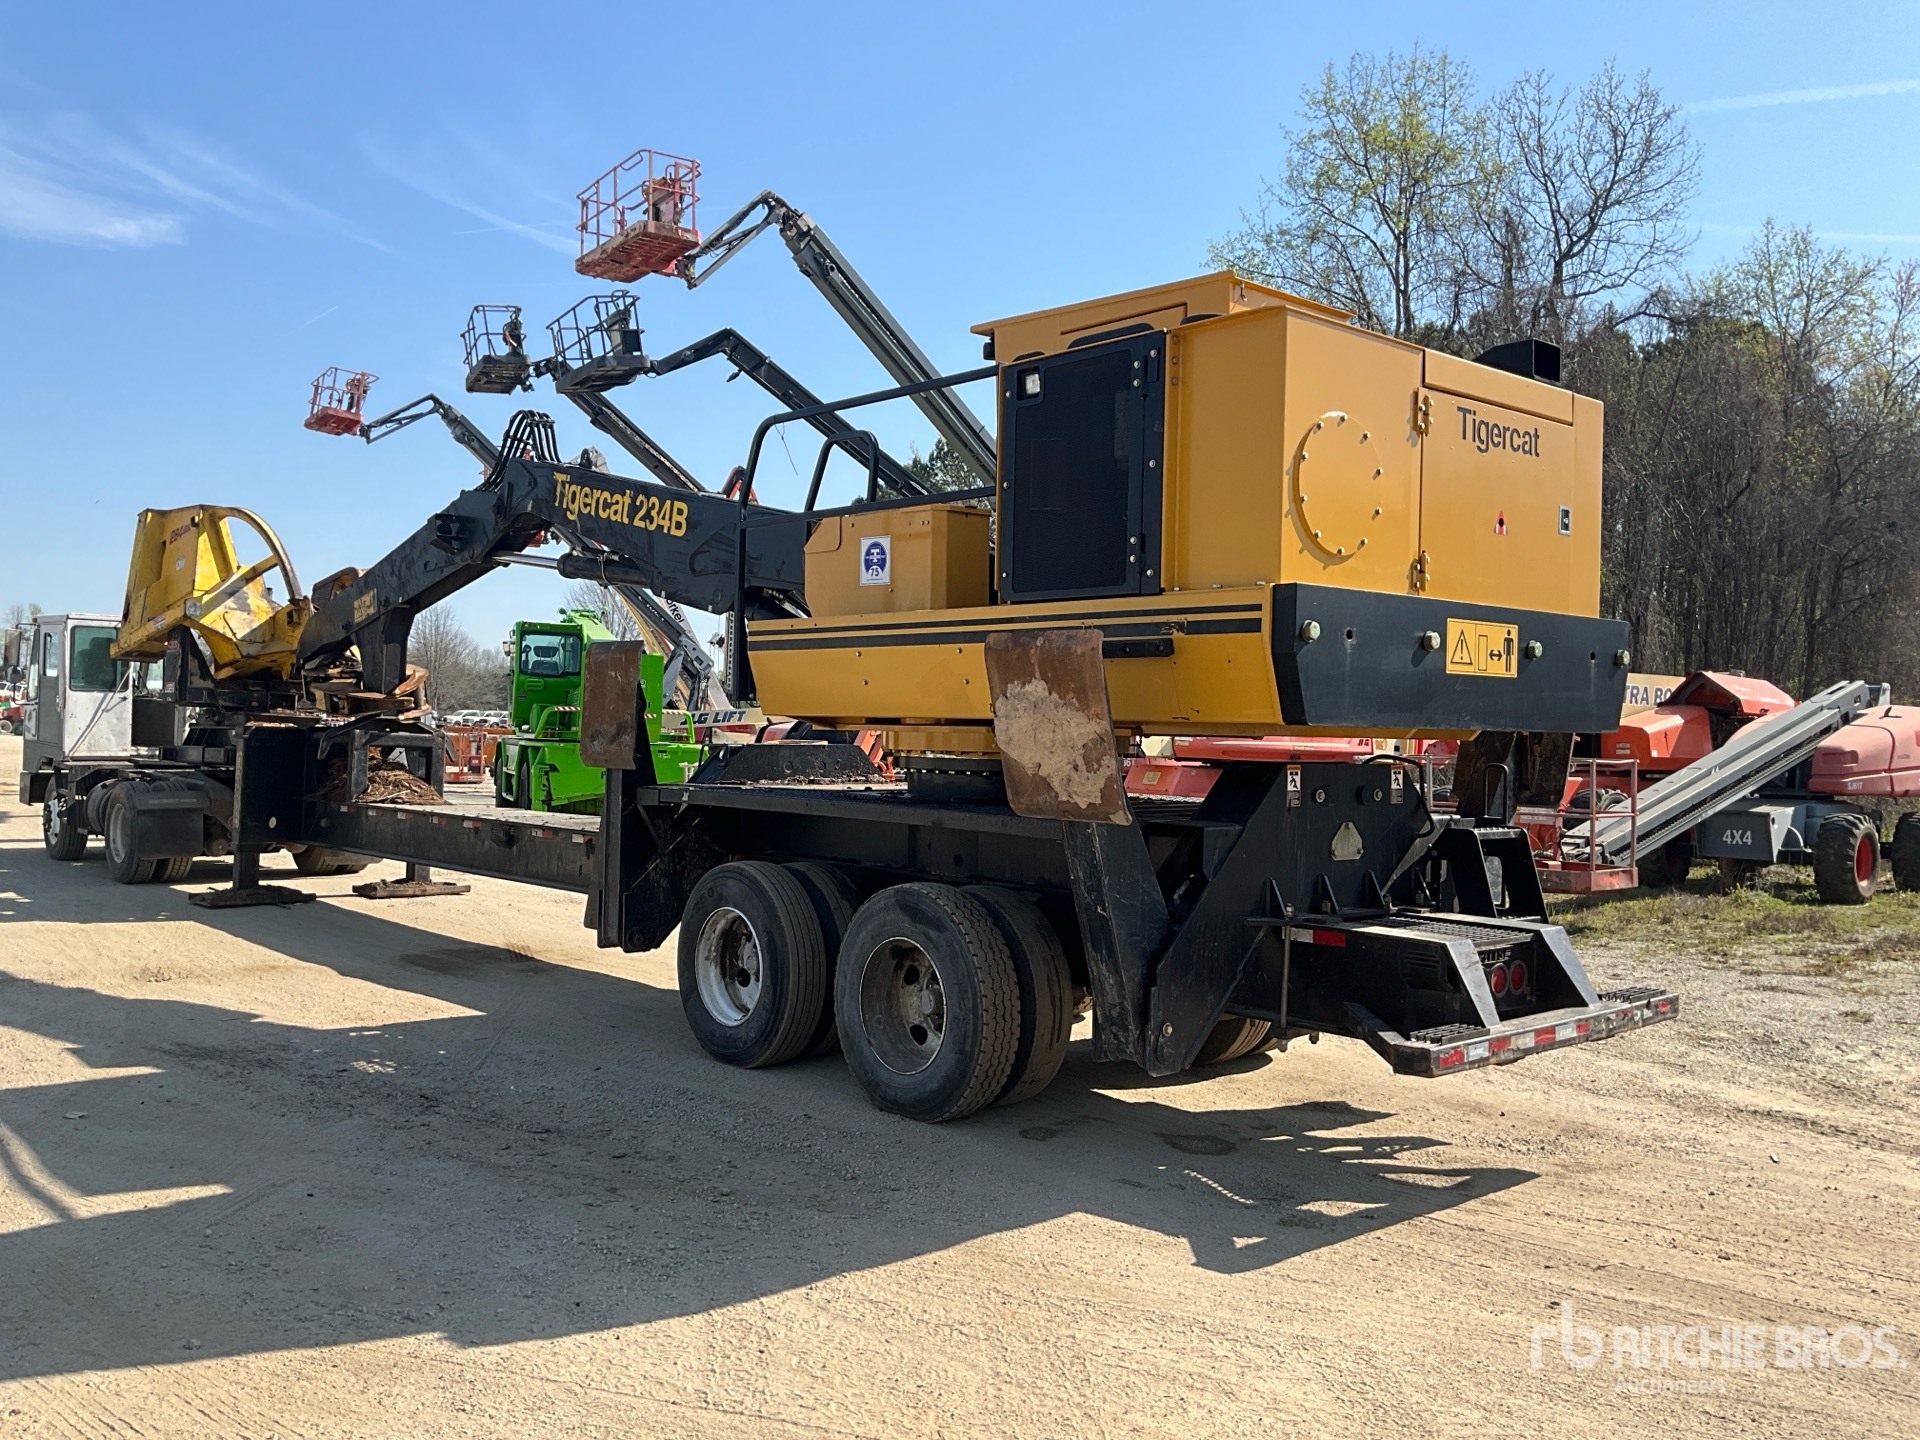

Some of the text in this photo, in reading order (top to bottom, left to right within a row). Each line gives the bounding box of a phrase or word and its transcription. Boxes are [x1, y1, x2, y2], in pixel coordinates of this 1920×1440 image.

[1456, 405, 1540, 458] Tigercat
[553, 471, 689, 537] Tigercat 234B
[666, 599, 685, 623] orkel
[1624, 685, 1673, 706] TRA BO
[712, 710, 747, 724] LIFT
[1722, 829, 1753, 846] 4X4
